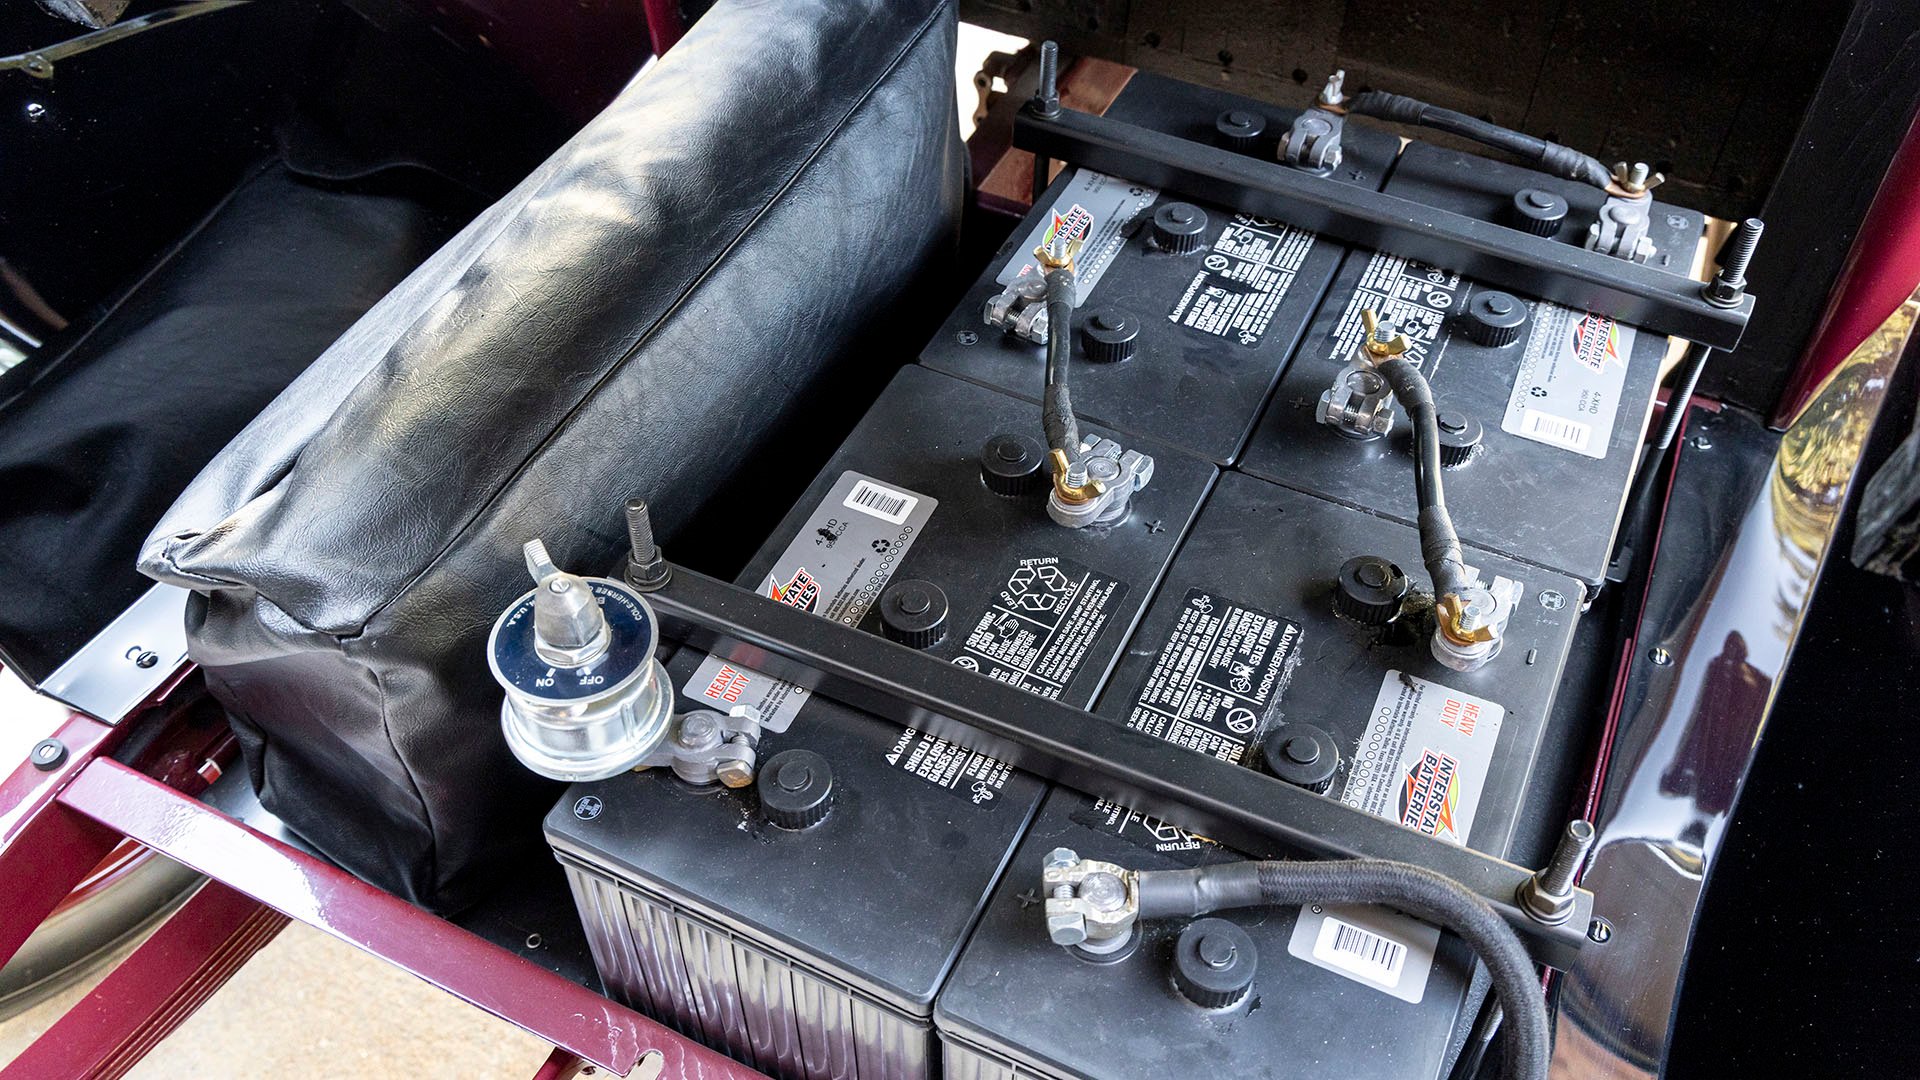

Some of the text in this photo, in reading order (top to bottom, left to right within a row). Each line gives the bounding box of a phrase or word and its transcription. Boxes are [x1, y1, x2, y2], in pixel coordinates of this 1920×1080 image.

[1578, 311, 1600, 362] BATTERIES
[1590, 314, 1612, 369] NTERSTATE
[815, 518, 838, 546] 4-HD
[836, 521, 849, 538] CCA
[1020, 557, 1059, 566] RETURN
[596, 585, 643, 622] COLE-HERSEE
[1000, 591, 1019, 610] LEAD
[1053, 581, 1079, 615] RECYCLE
[506, 605, 529, 628] U.S.A.
[1036, 645, 1059, 674] CAUTION:
[1055, 633, 1066, 645] FOR
[1062, 620, 1075, 634] SAFE
[1071, 605, 1083, 621] JUMP
[1080, 579, 1101, 605] STARTING,
[1175, 623, 1185, 631] TIP.
[1180, 614, 1189, 624] NOT
[966, 612, 996, 647] SULFURIC
[976, 632, 995, 652] ACID
[1044, 654, 1062, 677] FOLLOW
[1058, 617, 1086, 655] INSTRUCTIONS
[1085, 589, 1103, 611] VEHICLE
[1052, 655, 1071, 680] OWNER'S
[1067, 635, 1085, 656] MANUAL
[1081, 625, 1090, 634] OR
[1089, 608, 1101, 621] NOT
[1096, 582, 1118, 610] AVAILABLE,
[1170, 631, 1180, 643] KEEP
[1209, 608, 1243, 669] BLINDNESS OR INJURY
[1219, 611, 1255, 668] GASES CAN CAUSE
[1239, 615, 1266, 655] EXPLOSIVE
[986, 642, 1000, 655] CAN
[994, 638, 1012, 659] CAUSE
[1002, 630, 1029, 662] BLINDNESS
[1011, 633, 1037, 665] OR SEVERE
[1060, 614, 1107, 683] SEEK SERVICE ASSISTANCE.
[1249, 619, 1278, 666] SHIELD EYES
[1019, 648, 1037, 669] BURNS
[1148, 610, 1200, 703] KEEP OUT OF THE REACH OF CHILDREN.
[1158, 653, 1169, 665] CAPS
[1159, 614, 1211, 703] WATER. GET MEDICAL HELP FAST.
[1170, 617, 1220, 707] FLUSH EYES IMMEDIATELY WITH
[1255, 633, 1292, 702] DANGER/POISON
[535, 678, 555, 688] ON
[579, 676, 605, 686] OFF
[705, 665, 736, 699] HEAVY
[723, 674, 751, 703] DUTY
[1147, 677, 1156, 688] AND
[1139, 687, 1152, 701] LEVEL.
[1181, 689, 1201, 719] SMOKING
[1193, 693, 1211, 718] FLAMES
[1221, 695, 1235, 709] NO
[764, 705, 779, 722] Marketed
[1129, 707, 1142, 723] SEEK
[1203, 696, 1221, 722] SPARKS
[1440, 699, 1461, 728] DUTY
[1458, 702, 1480, 737] HEAVY
[1144, 713, 1158, 734] FOLLO
[1151, 717, 1167, 738] CAUTI
[1183, 725, 1194, 736] OR
[1188, 728, 1203, 750] BLIND
[1208, 736, 1221, 751] CAN
[1215, 739, 1233, 761] ACID
[904, 741, 930, 772] SHIELD
[966, 755, 984, 776] FLUSH
[1226, 744, 1244, 765] SULF
[927, 753, 952, 782] GASES
[938, 751, 966, 787] BLINDNESS
[986, 761, 1005, 785] KEEP OU
[994, 780, 1004, 789] DO
[999, 770, 1010, 781] NOT
[1405, 754, 1438, 827] BATTERIE
[1420, 757, 1455, 835] INTERSTAT
[1105, 805, 1122, 826] RTING,
[1156, 841, 1200, 852] RETURN
